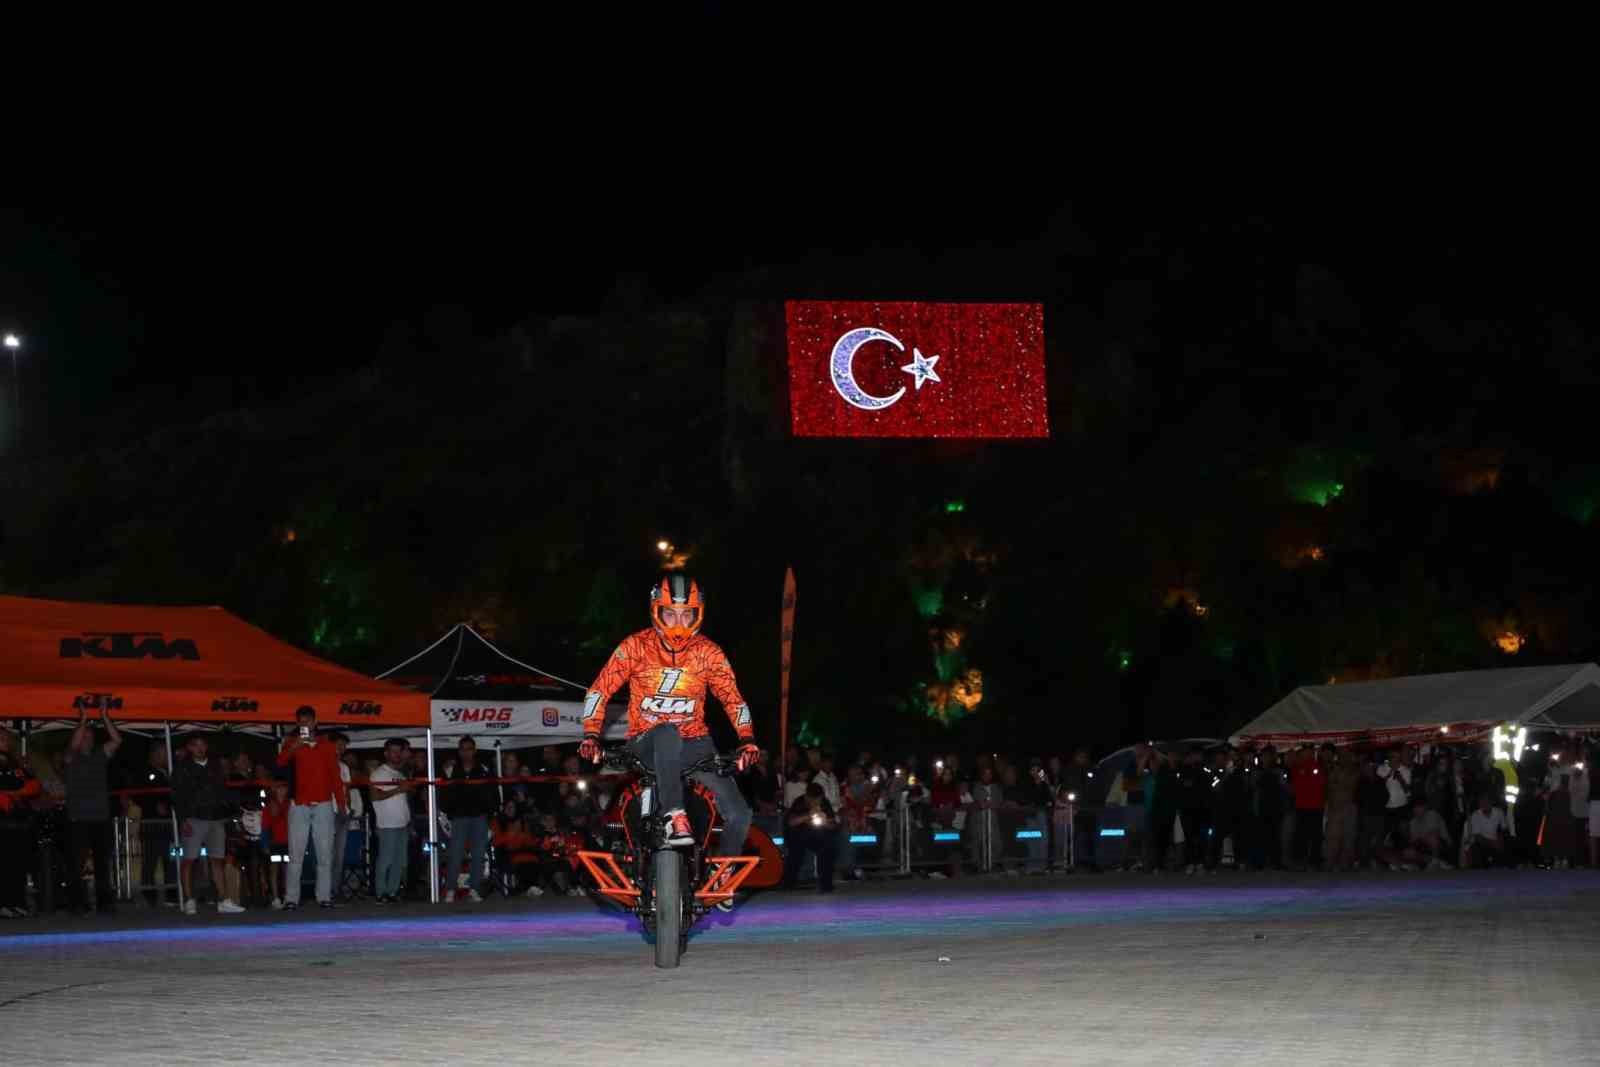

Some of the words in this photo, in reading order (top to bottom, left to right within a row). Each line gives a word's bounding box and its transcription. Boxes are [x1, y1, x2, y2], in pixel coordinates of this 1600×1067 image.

[60, 632, 200, 660] KTM
[211, 697, 258, 712] KTM
[338, 700, 383, 715] KTM
[640, 695, 696, 714] KTM
